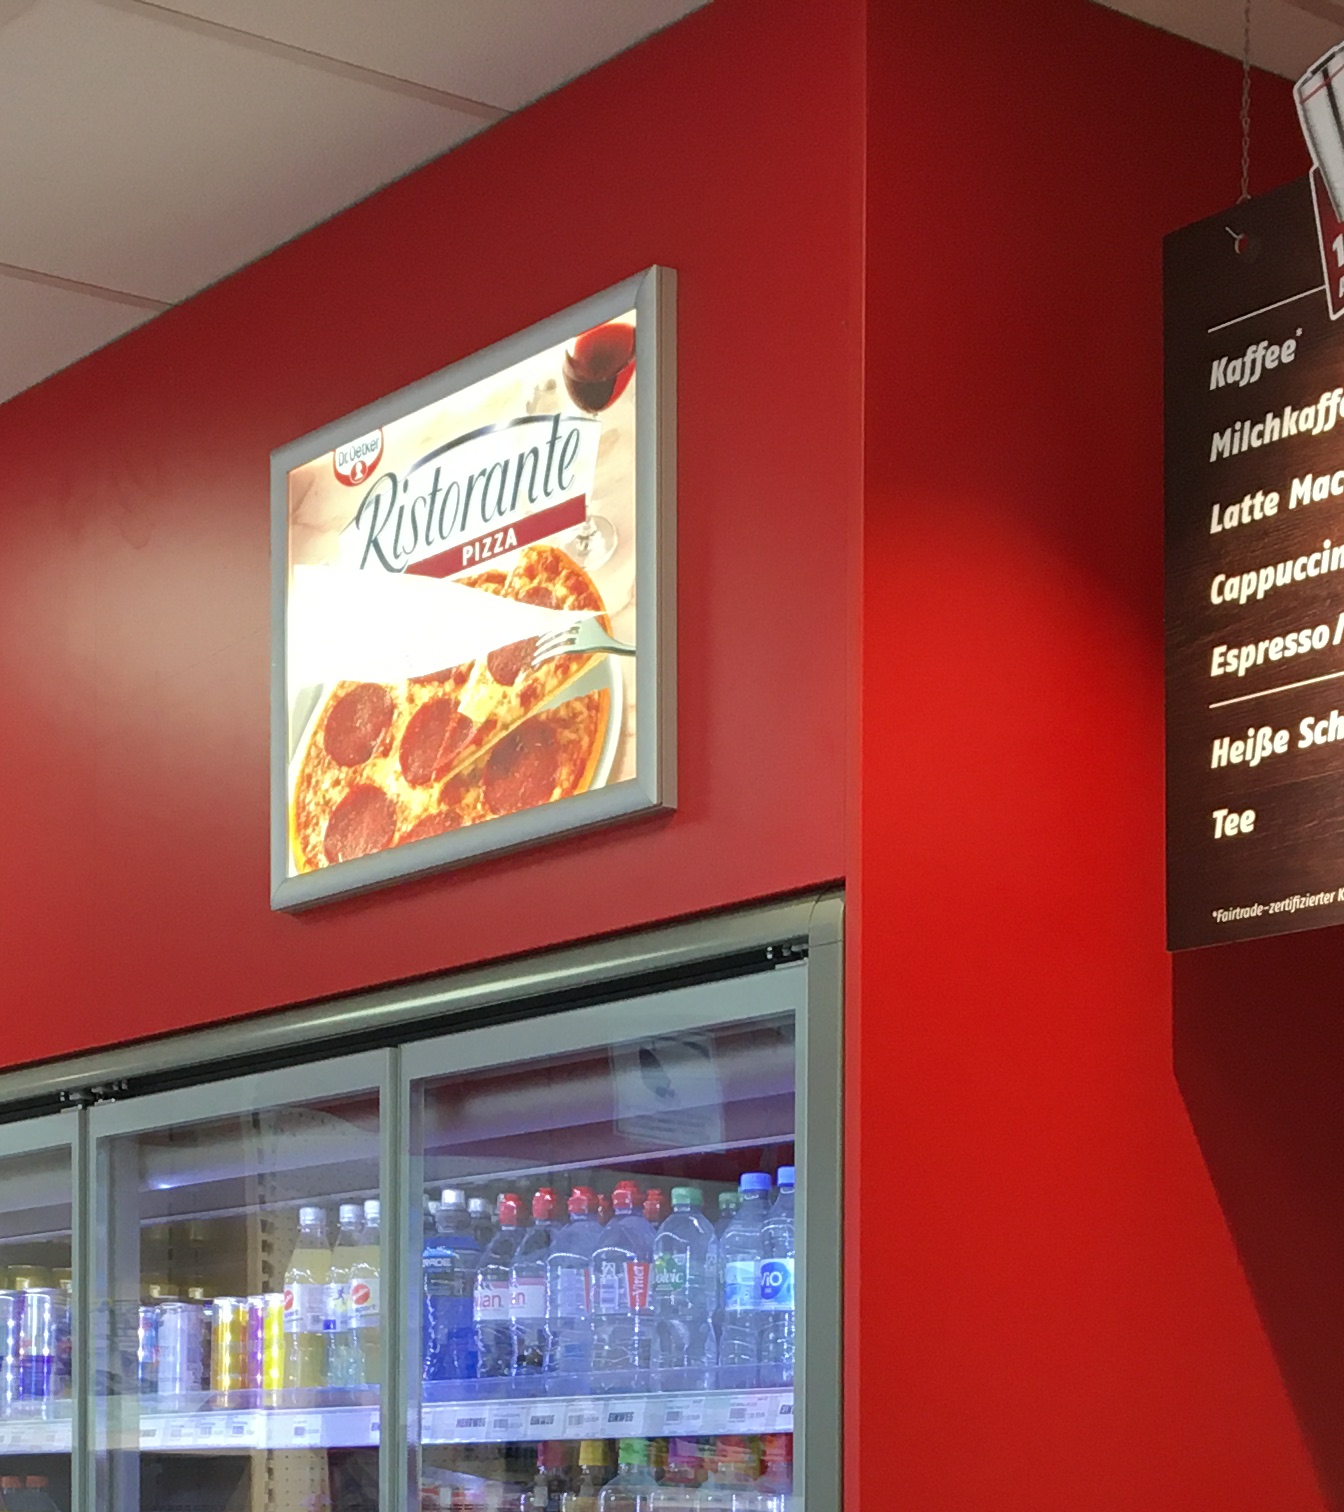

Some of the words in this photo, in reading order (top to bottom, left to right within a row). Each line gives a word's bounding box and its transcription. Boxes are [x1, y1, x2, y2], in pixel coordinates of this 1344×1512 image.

[355, 413, 580, 574] Ristorante
[1209, 483, 1278, 534] Latte
[462, 528, 517, 566] PIZZA
[1211, 726, 1289, 769] Heiße
[1212, 807, 1256, 840] Tee
[607, 1411, 635, 1423] EINWEG
